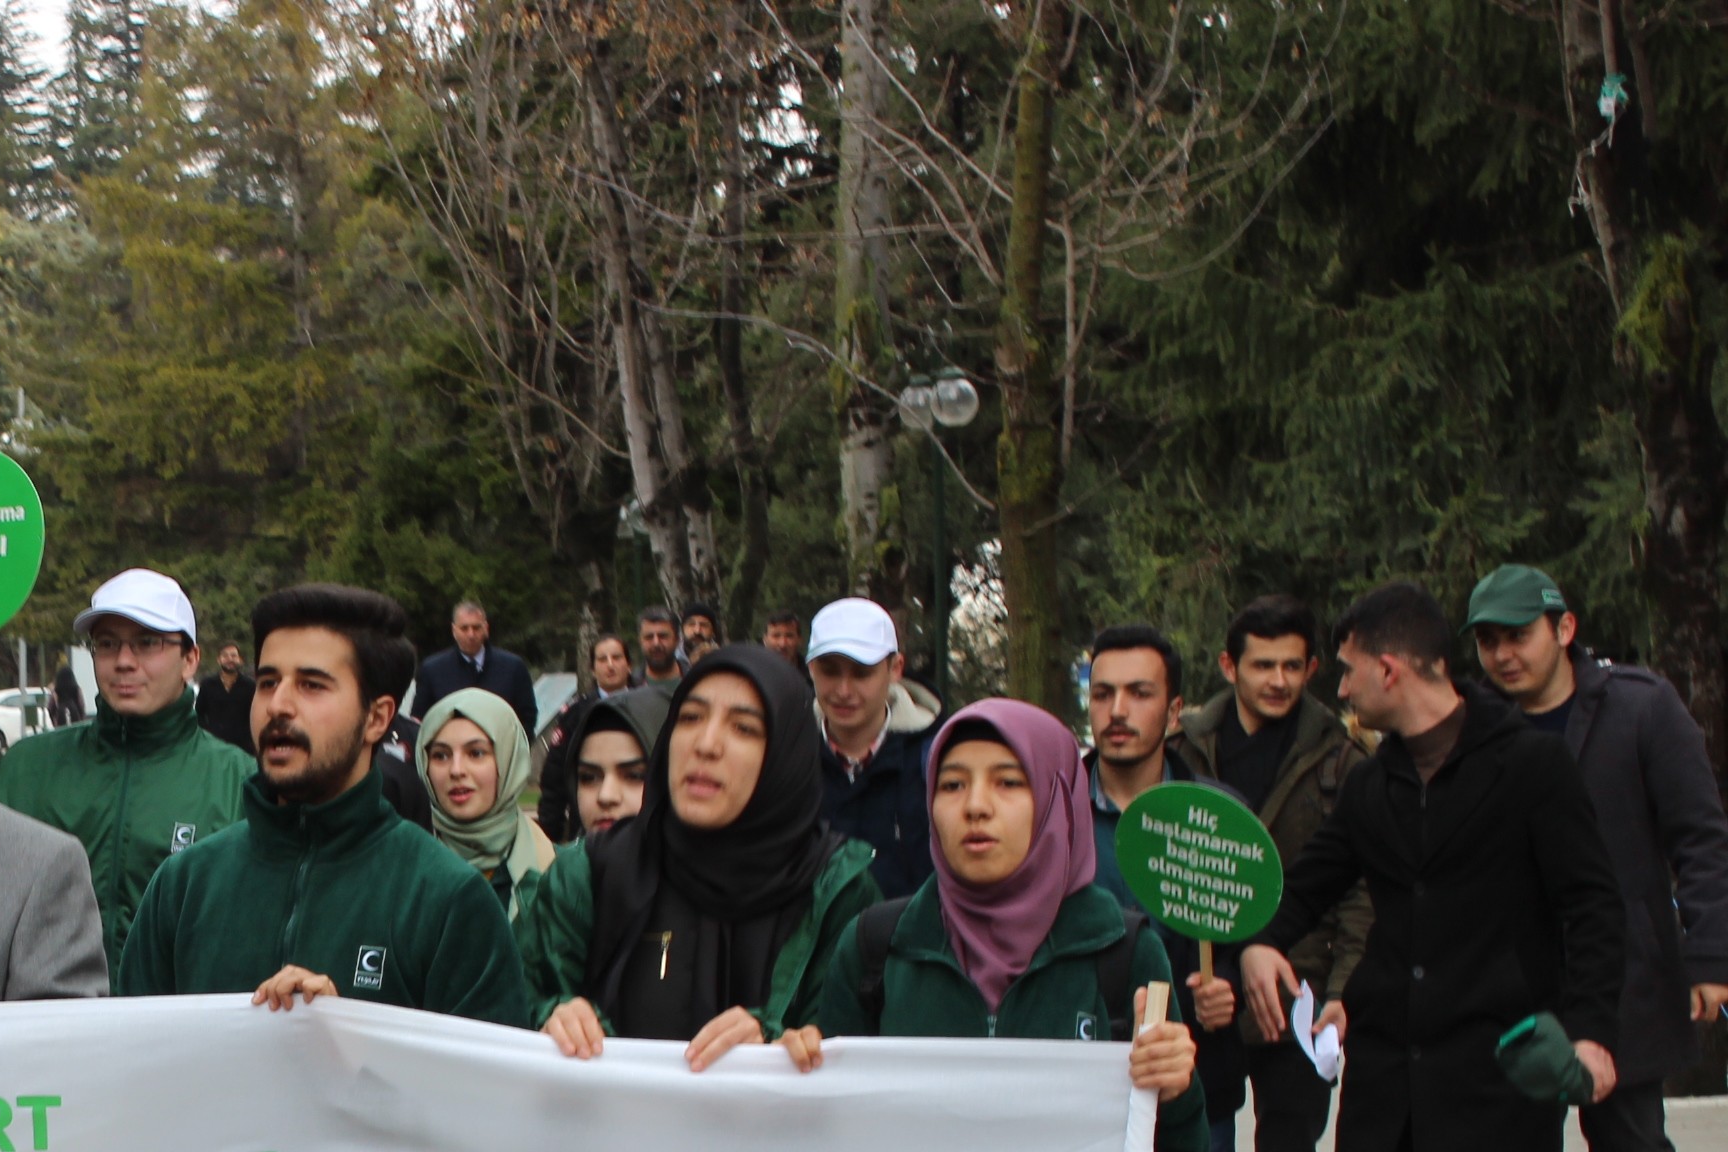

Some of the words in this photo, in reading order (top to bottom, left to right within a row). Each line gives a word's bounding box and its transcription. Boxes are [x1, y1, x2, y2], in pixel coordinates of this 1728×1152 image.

[1188, 805, 1218, 832] Hiç
[1141, 812, 1265, 863] başlamamak
[1166, 838, 1237, 875] bağımlı
[1148, 856, 1254, 900] olmamanın
[1160, 880, 1182, 900] en
[1187, 886, 1240, 918] kolay
[1162, 899, 1236, 934] yoludur
